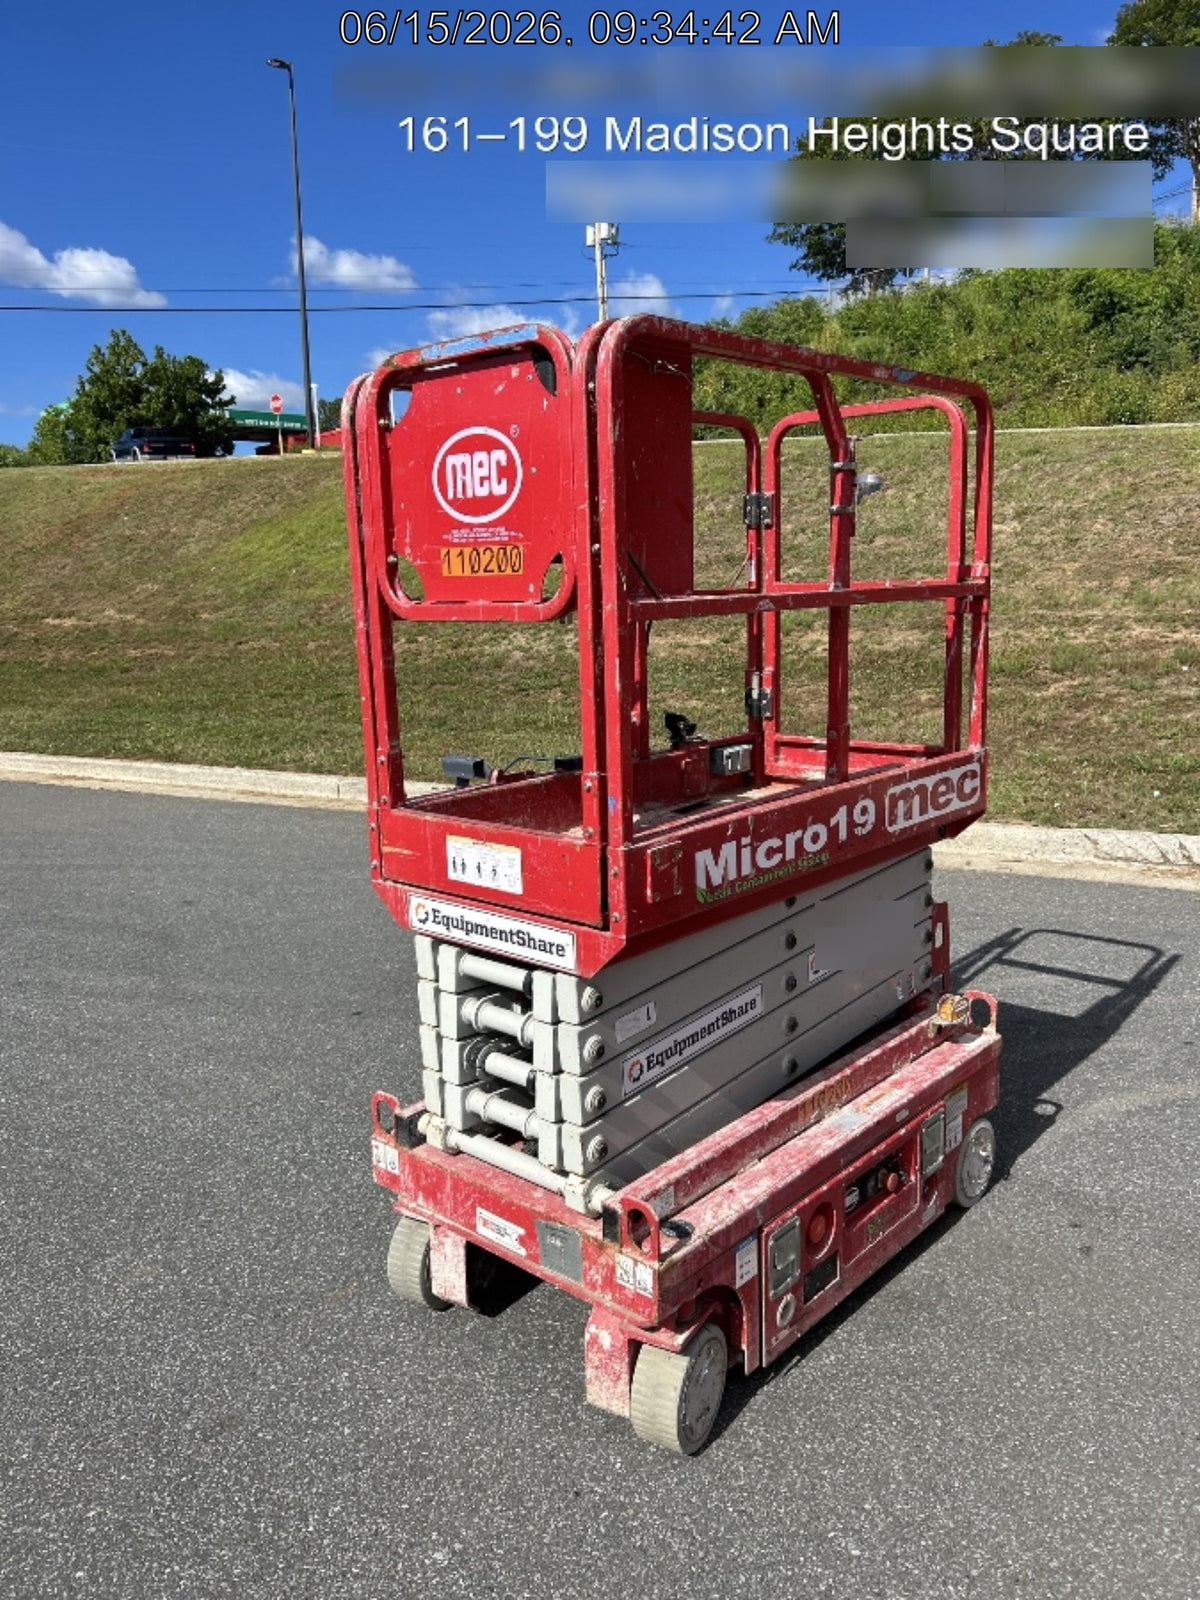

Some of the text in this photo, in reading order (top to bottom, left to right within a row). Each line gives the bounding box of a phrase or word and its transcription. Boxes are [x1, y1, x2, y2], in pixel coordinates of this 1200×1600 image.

[443, 546, 522, 575] 110200
[431, 908, 567, 957] EquipmentShare
[645, 998, 757, 1072] EquipmentShare
